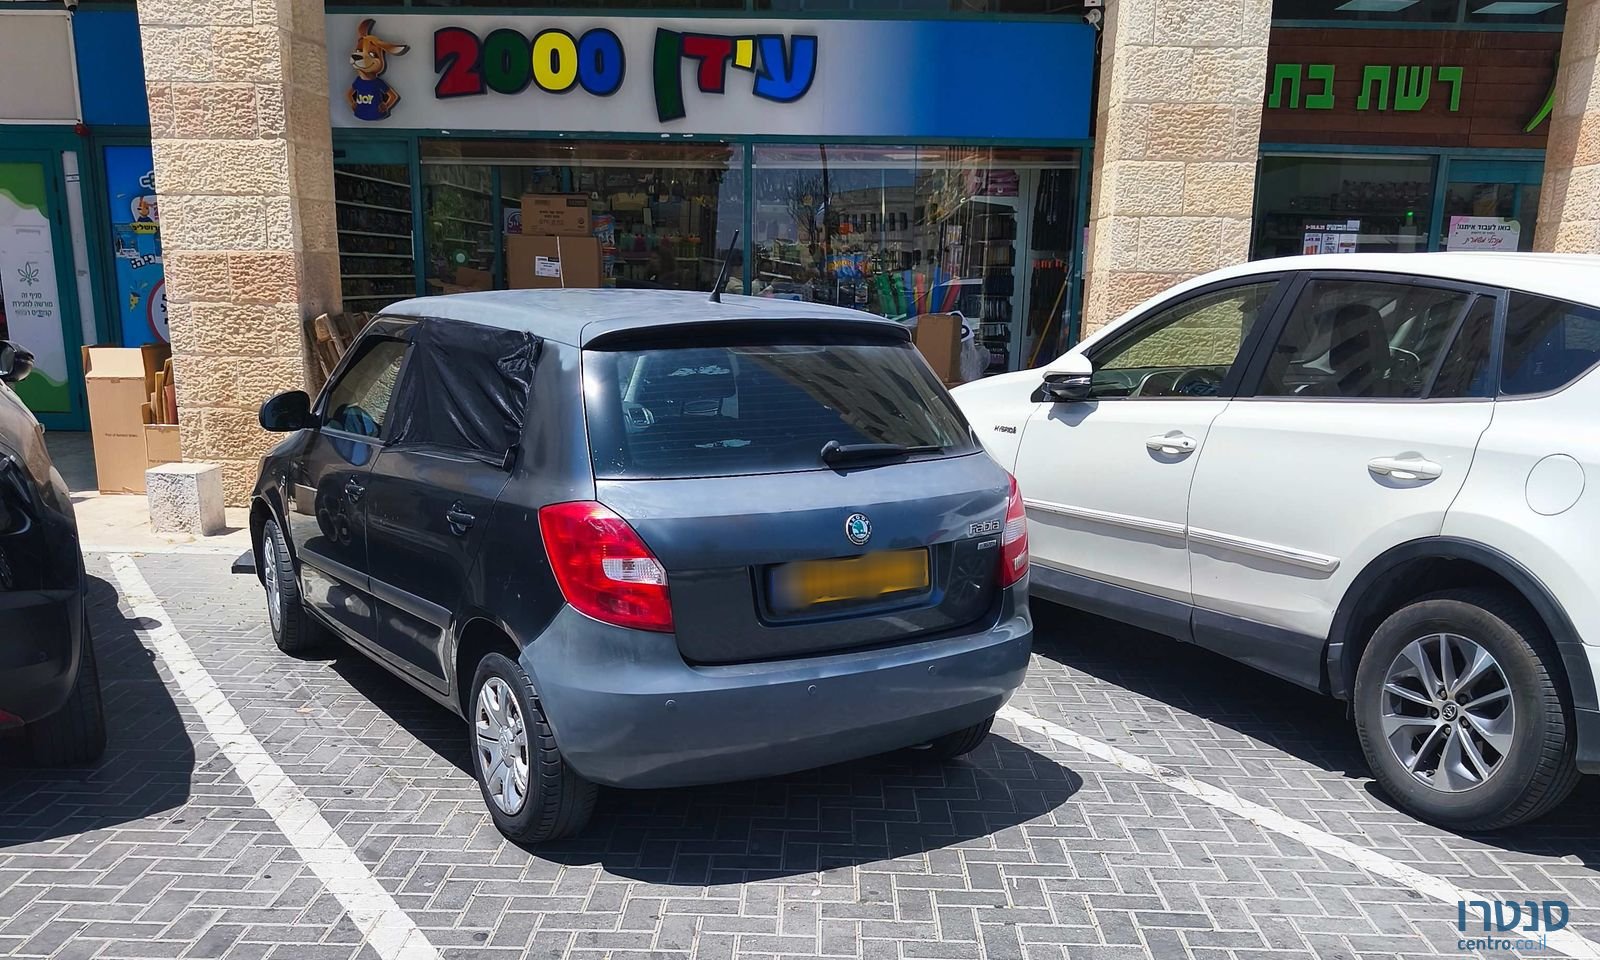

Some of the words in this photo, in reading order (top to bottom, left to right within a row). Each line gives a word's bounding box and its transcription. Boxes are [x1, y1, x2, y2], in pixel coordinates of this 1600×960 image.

[434, 25, 626, 99] 2000
[652, 26, 818, 123] עידן
[1356, 65, 1464, 112] רשת
[356, 94, 375, 105] JOY
[1478, 223, 1496, 231] לעבור
[30, 292, 42, 300] סניף
[969, 520, 1000, 536] Fabia
